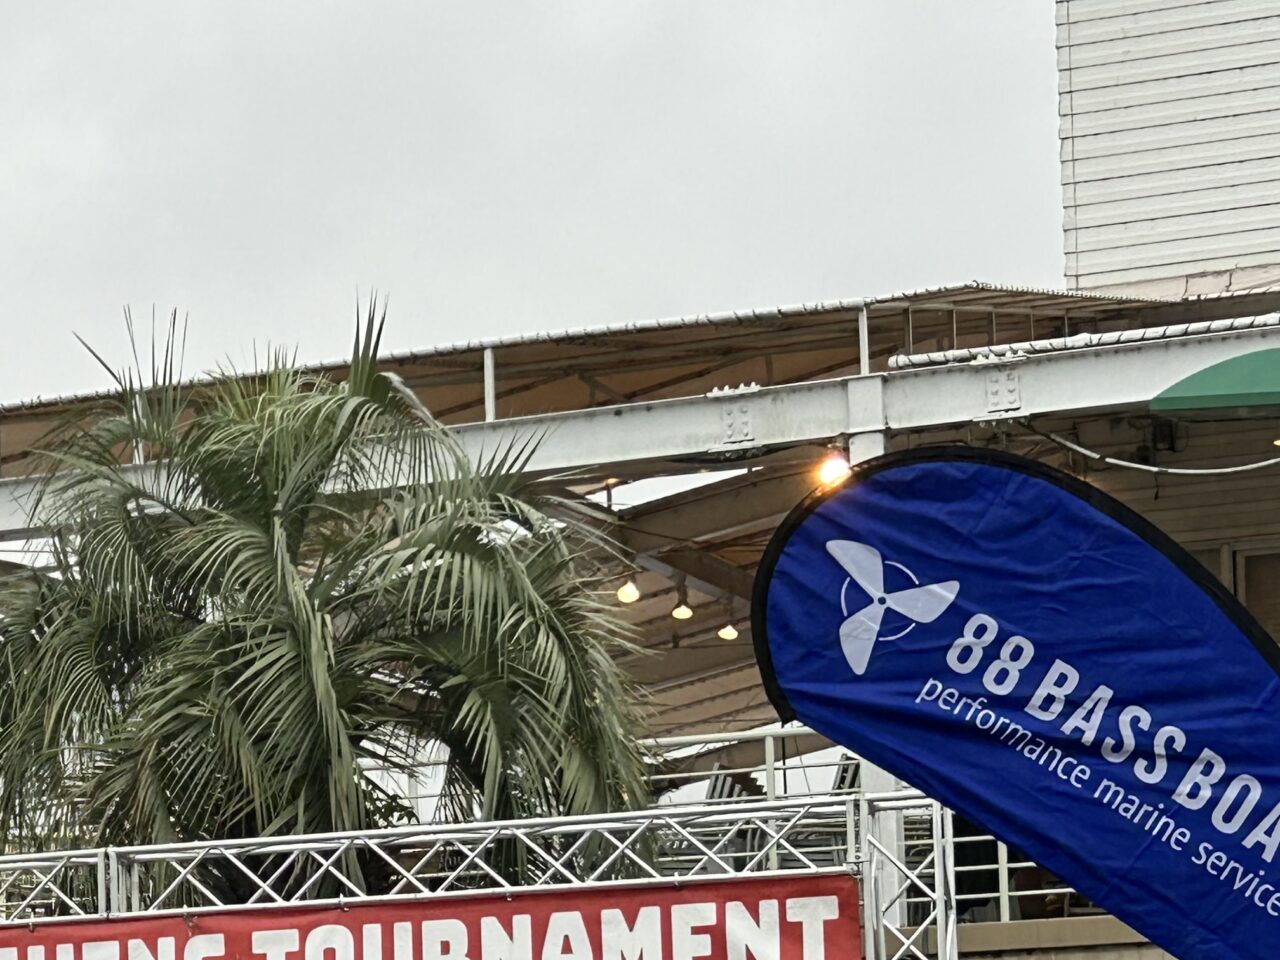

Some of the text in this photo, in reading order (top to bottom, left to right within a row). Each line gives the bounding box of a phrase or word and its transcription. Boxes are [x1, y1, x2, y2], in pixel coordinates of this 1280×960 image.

[945, 612, 1035, 697] 88
[914, 676, 1280, 917] performance marine service
